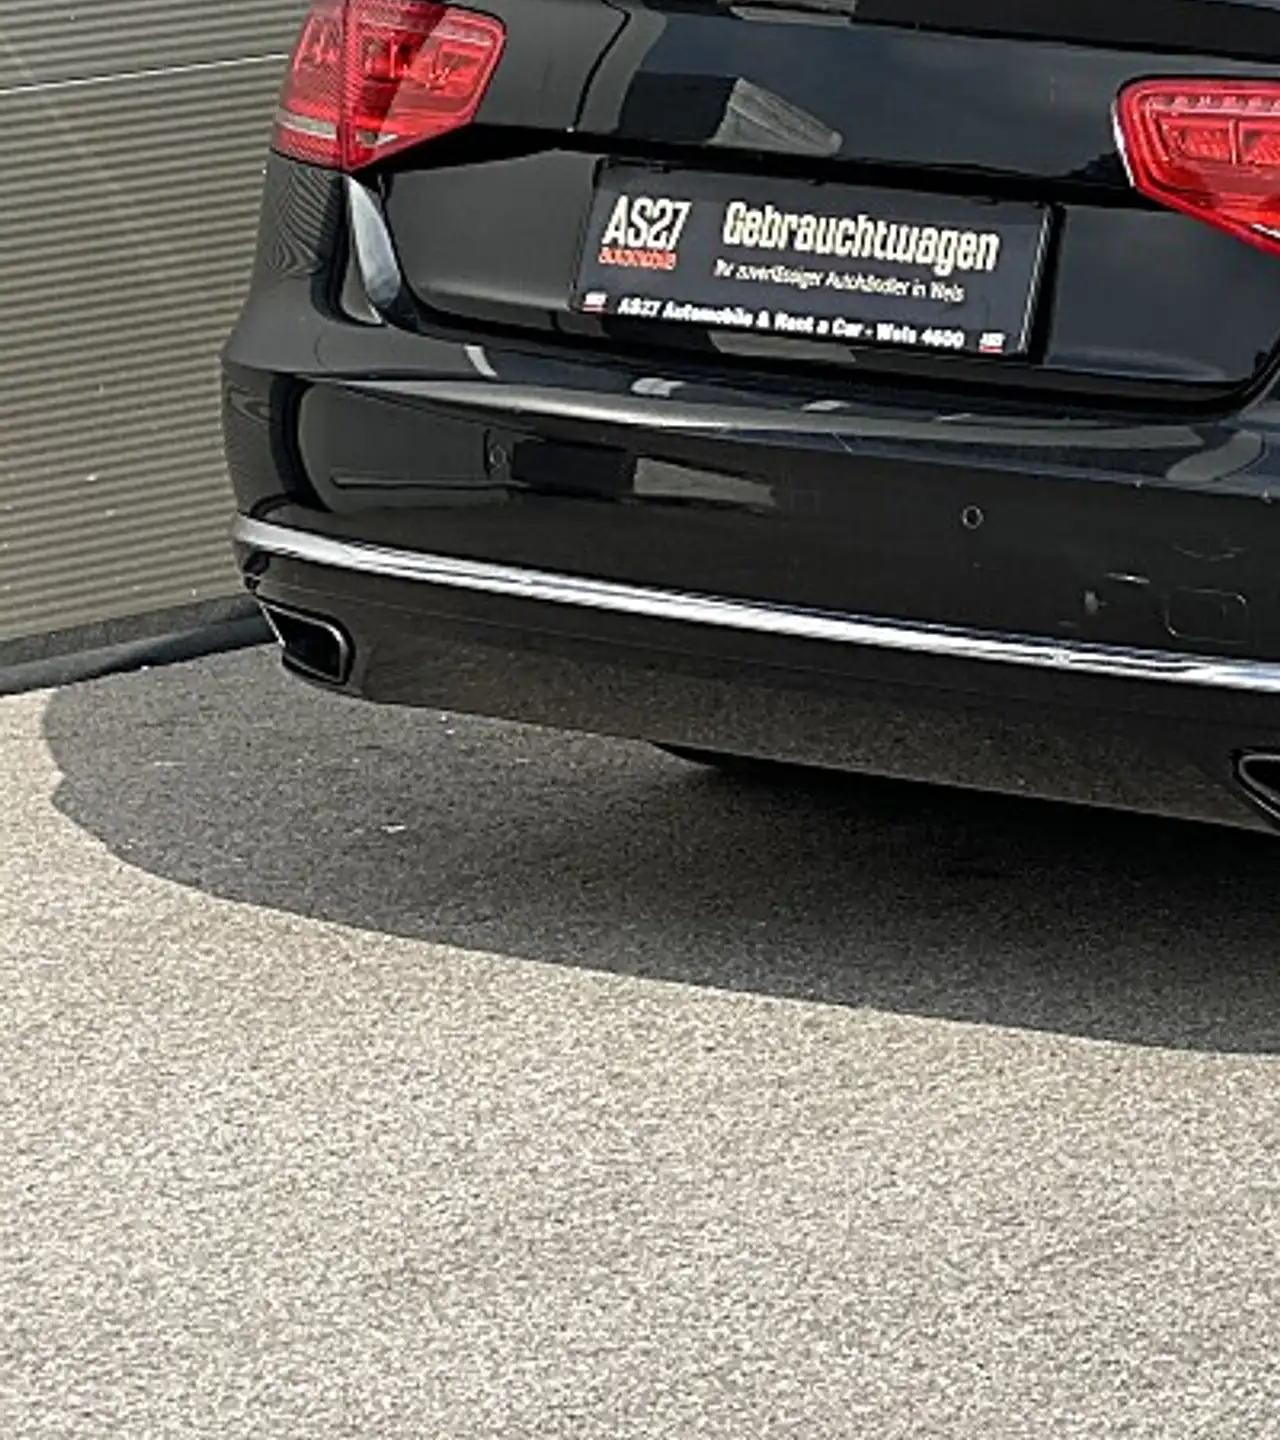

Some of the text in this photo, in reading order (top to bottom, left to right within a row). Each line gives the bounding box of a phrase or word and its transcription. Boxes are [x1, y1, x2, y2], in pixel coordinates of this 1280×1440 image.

[602, 195, 692, 250] AS27
[723, 200, 999, 276] Gebrauchtwagen
[662, 300, 752, 327] Automobile
[816, 319, 830, 335] a
[832, 317, 864, 337] Car
